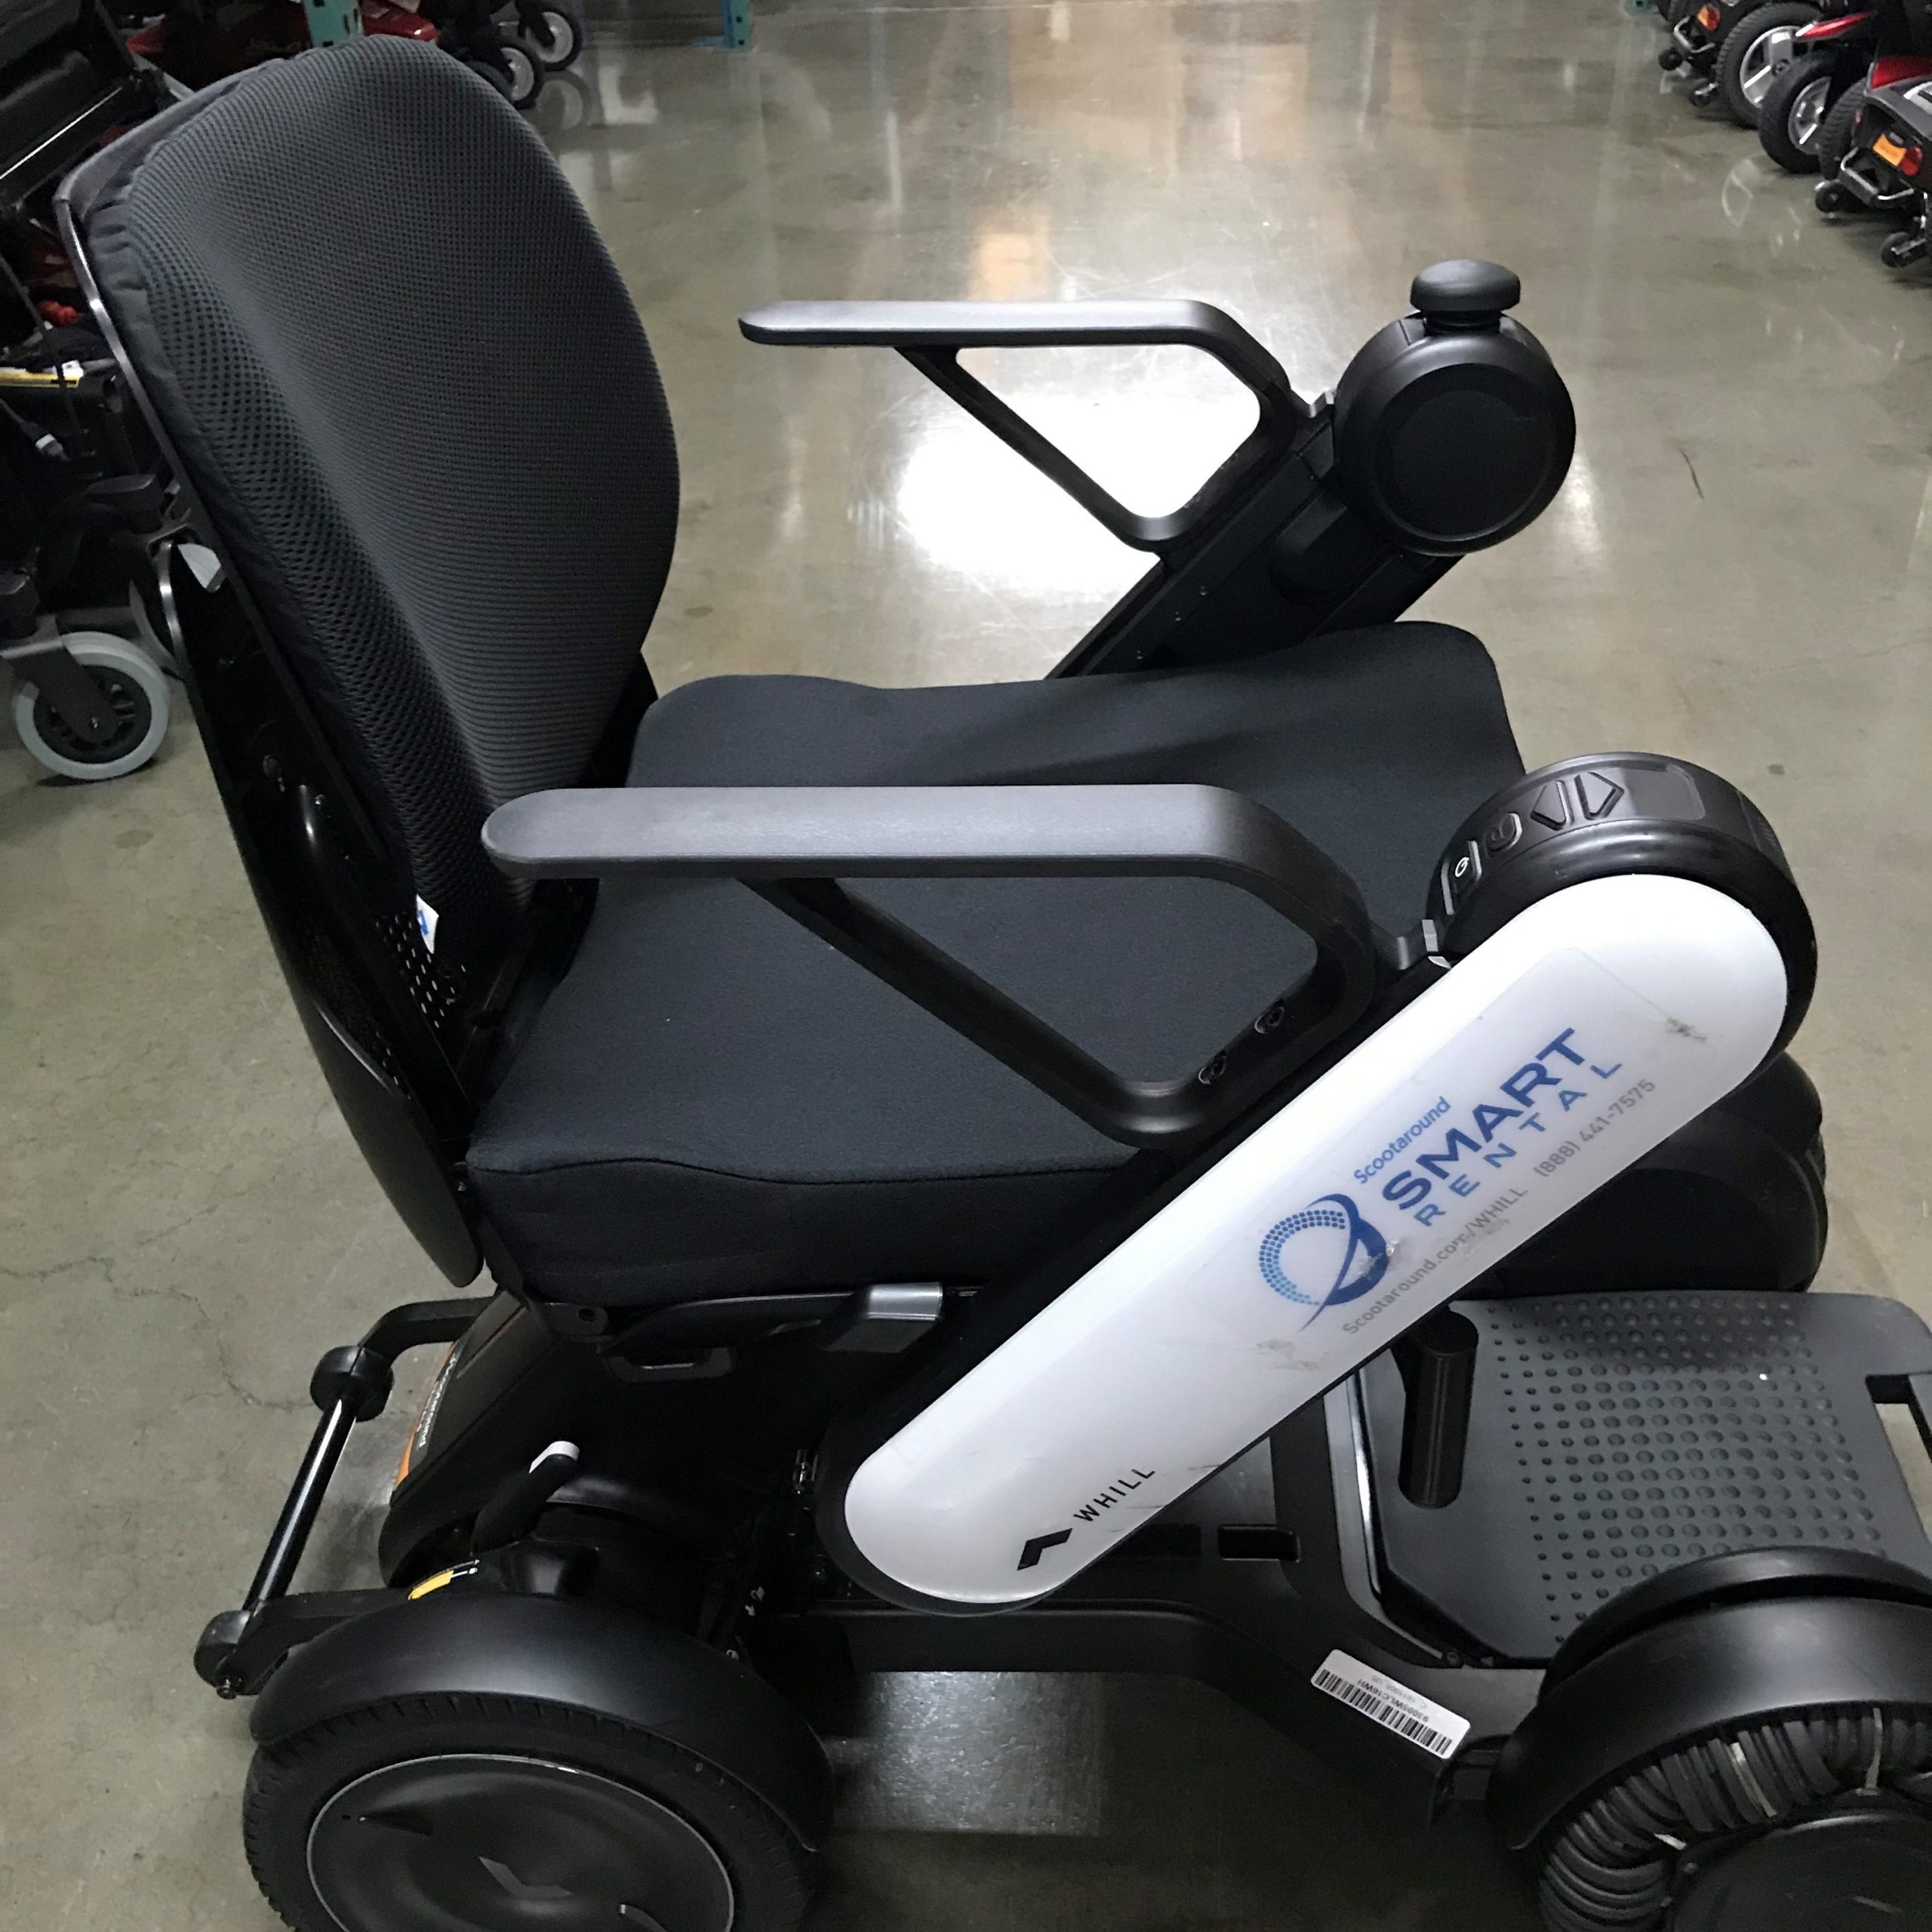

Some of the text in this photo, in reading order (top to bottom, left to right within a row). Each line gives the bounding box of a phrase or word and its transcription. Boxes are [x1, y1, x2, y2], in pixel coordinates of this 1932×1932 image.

[1354, 1097, 1451, 1184] Scootaround
[1383, 1027, 1585, 1210] SMART
[1414, 1063, 1622, 1226] RENTAL
[1343, 1079, 1656, 1334] Scootaround.com/WHILL (888) 441-7575
[1073, 1469, 1155, 1521] WHILL
